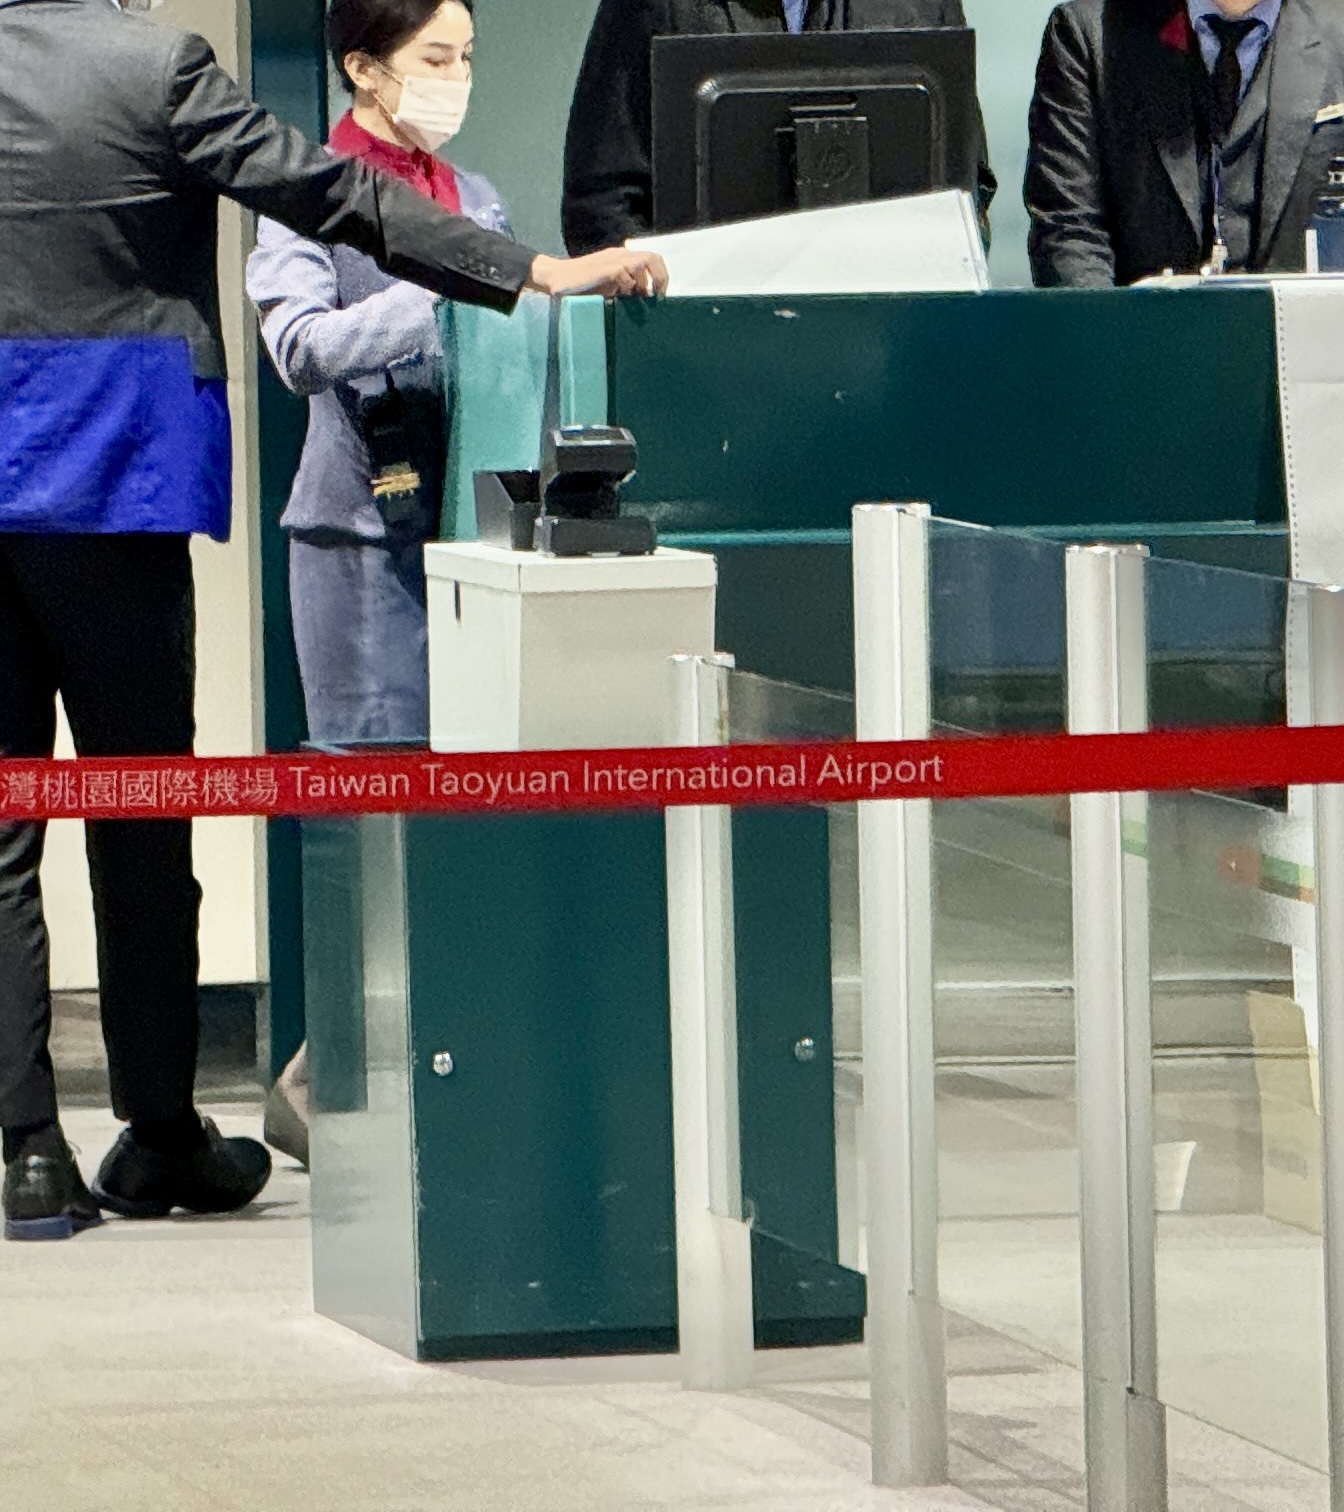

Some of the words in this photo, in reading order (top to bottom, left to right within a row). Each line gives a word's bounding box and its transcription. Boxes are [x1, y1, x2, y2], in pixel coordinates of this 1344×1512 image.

[287, 764, 411, 799] Taiwan
[420, 762, 571, 805] Taoyuan
[582, 756, 808, 793] International
[815, 751, 945, 802] Airport
